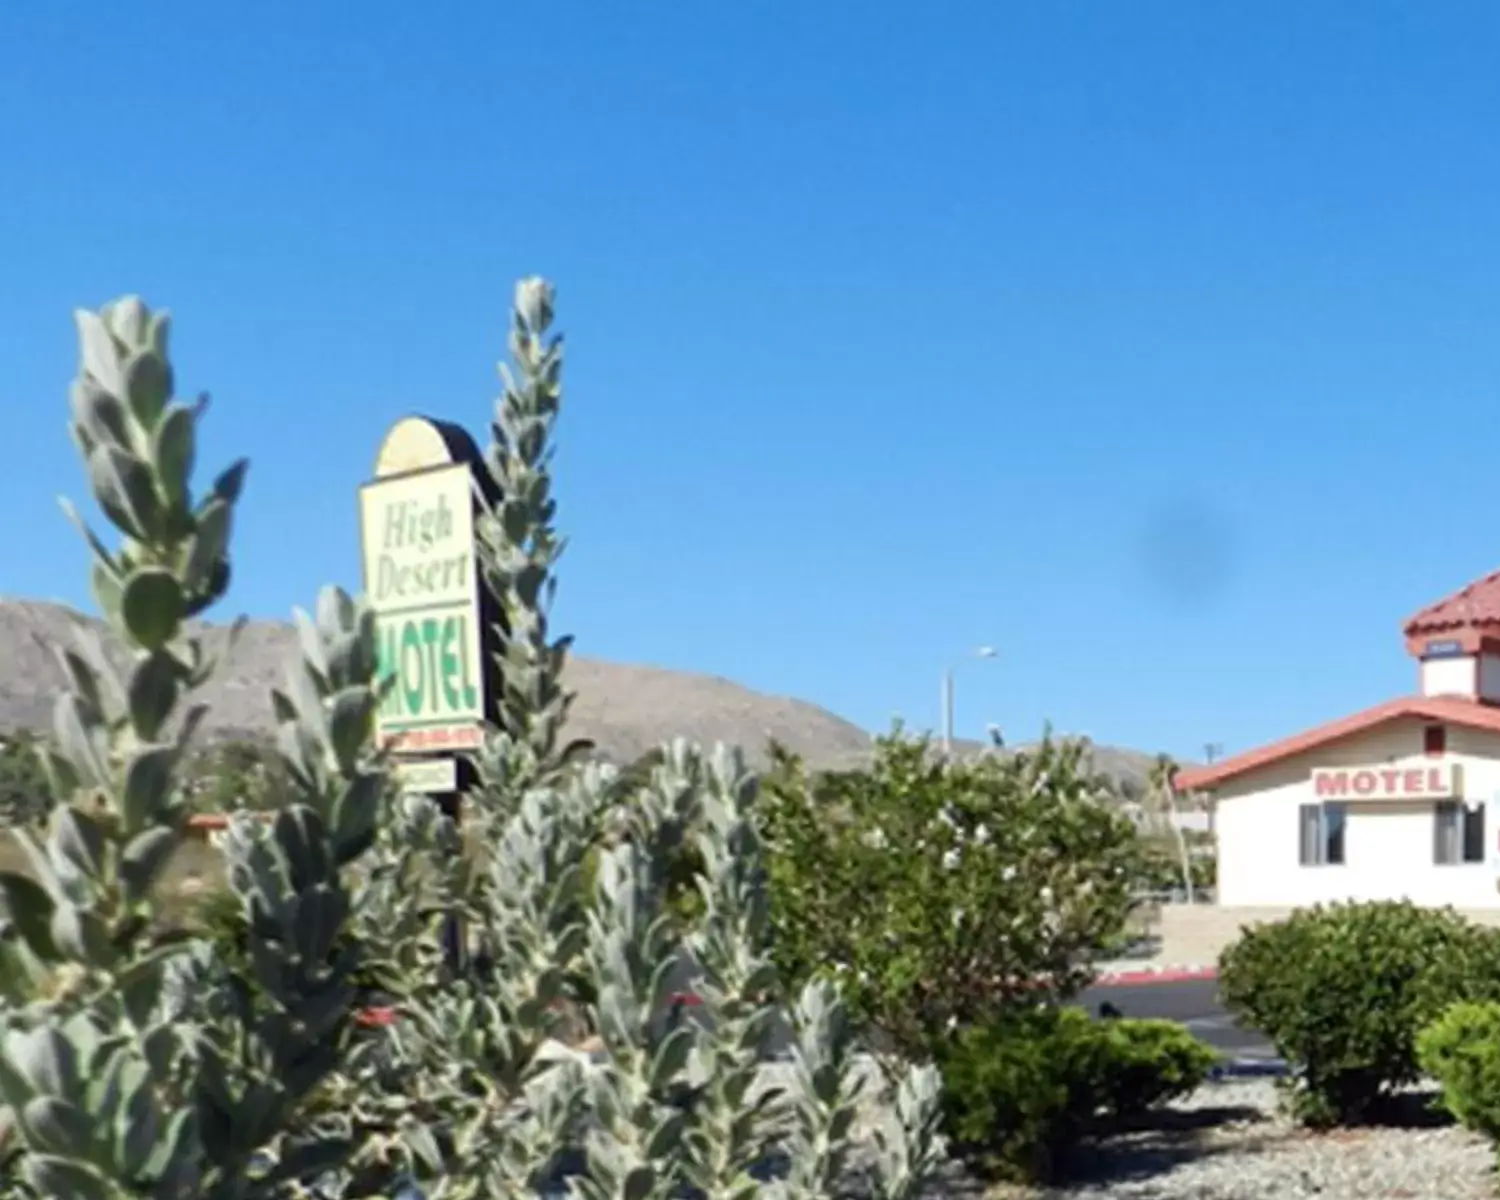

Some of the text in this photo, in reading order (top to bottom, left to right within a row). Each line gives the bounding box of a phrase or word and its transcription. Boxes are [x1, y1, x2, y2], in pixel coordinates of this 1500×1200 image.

[384, 494, 452, 553] High
[376, 553, 467, 600] Desert
[1315, 769, 1448, 795] MOTEL
